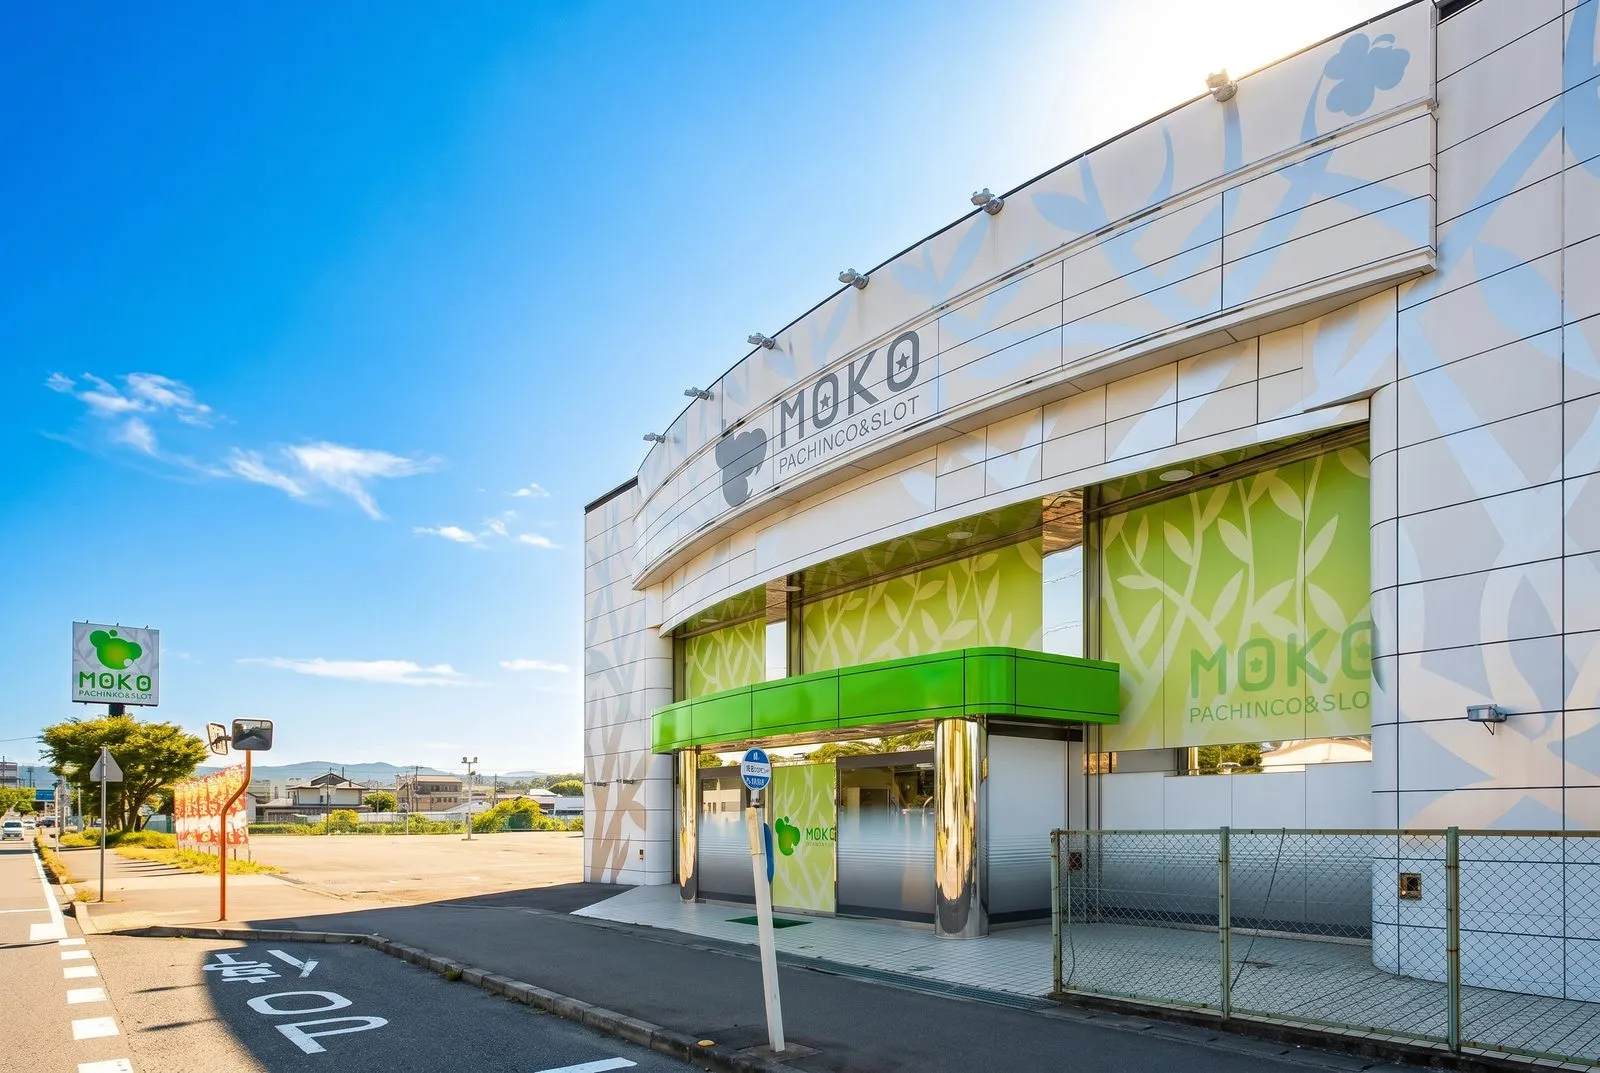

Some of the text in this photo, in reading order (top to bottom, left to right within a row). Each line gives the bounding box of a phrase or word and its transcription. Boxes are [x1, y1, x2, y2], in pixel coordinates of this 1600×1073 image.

[780, 331, 920, 449] MOKO
[779, 395, 920, 474] PACHINCO&SLOT
[79, 671, 152, 692] MOKO
[1189, 690, 1370, 724] PACHINCO&SLO
